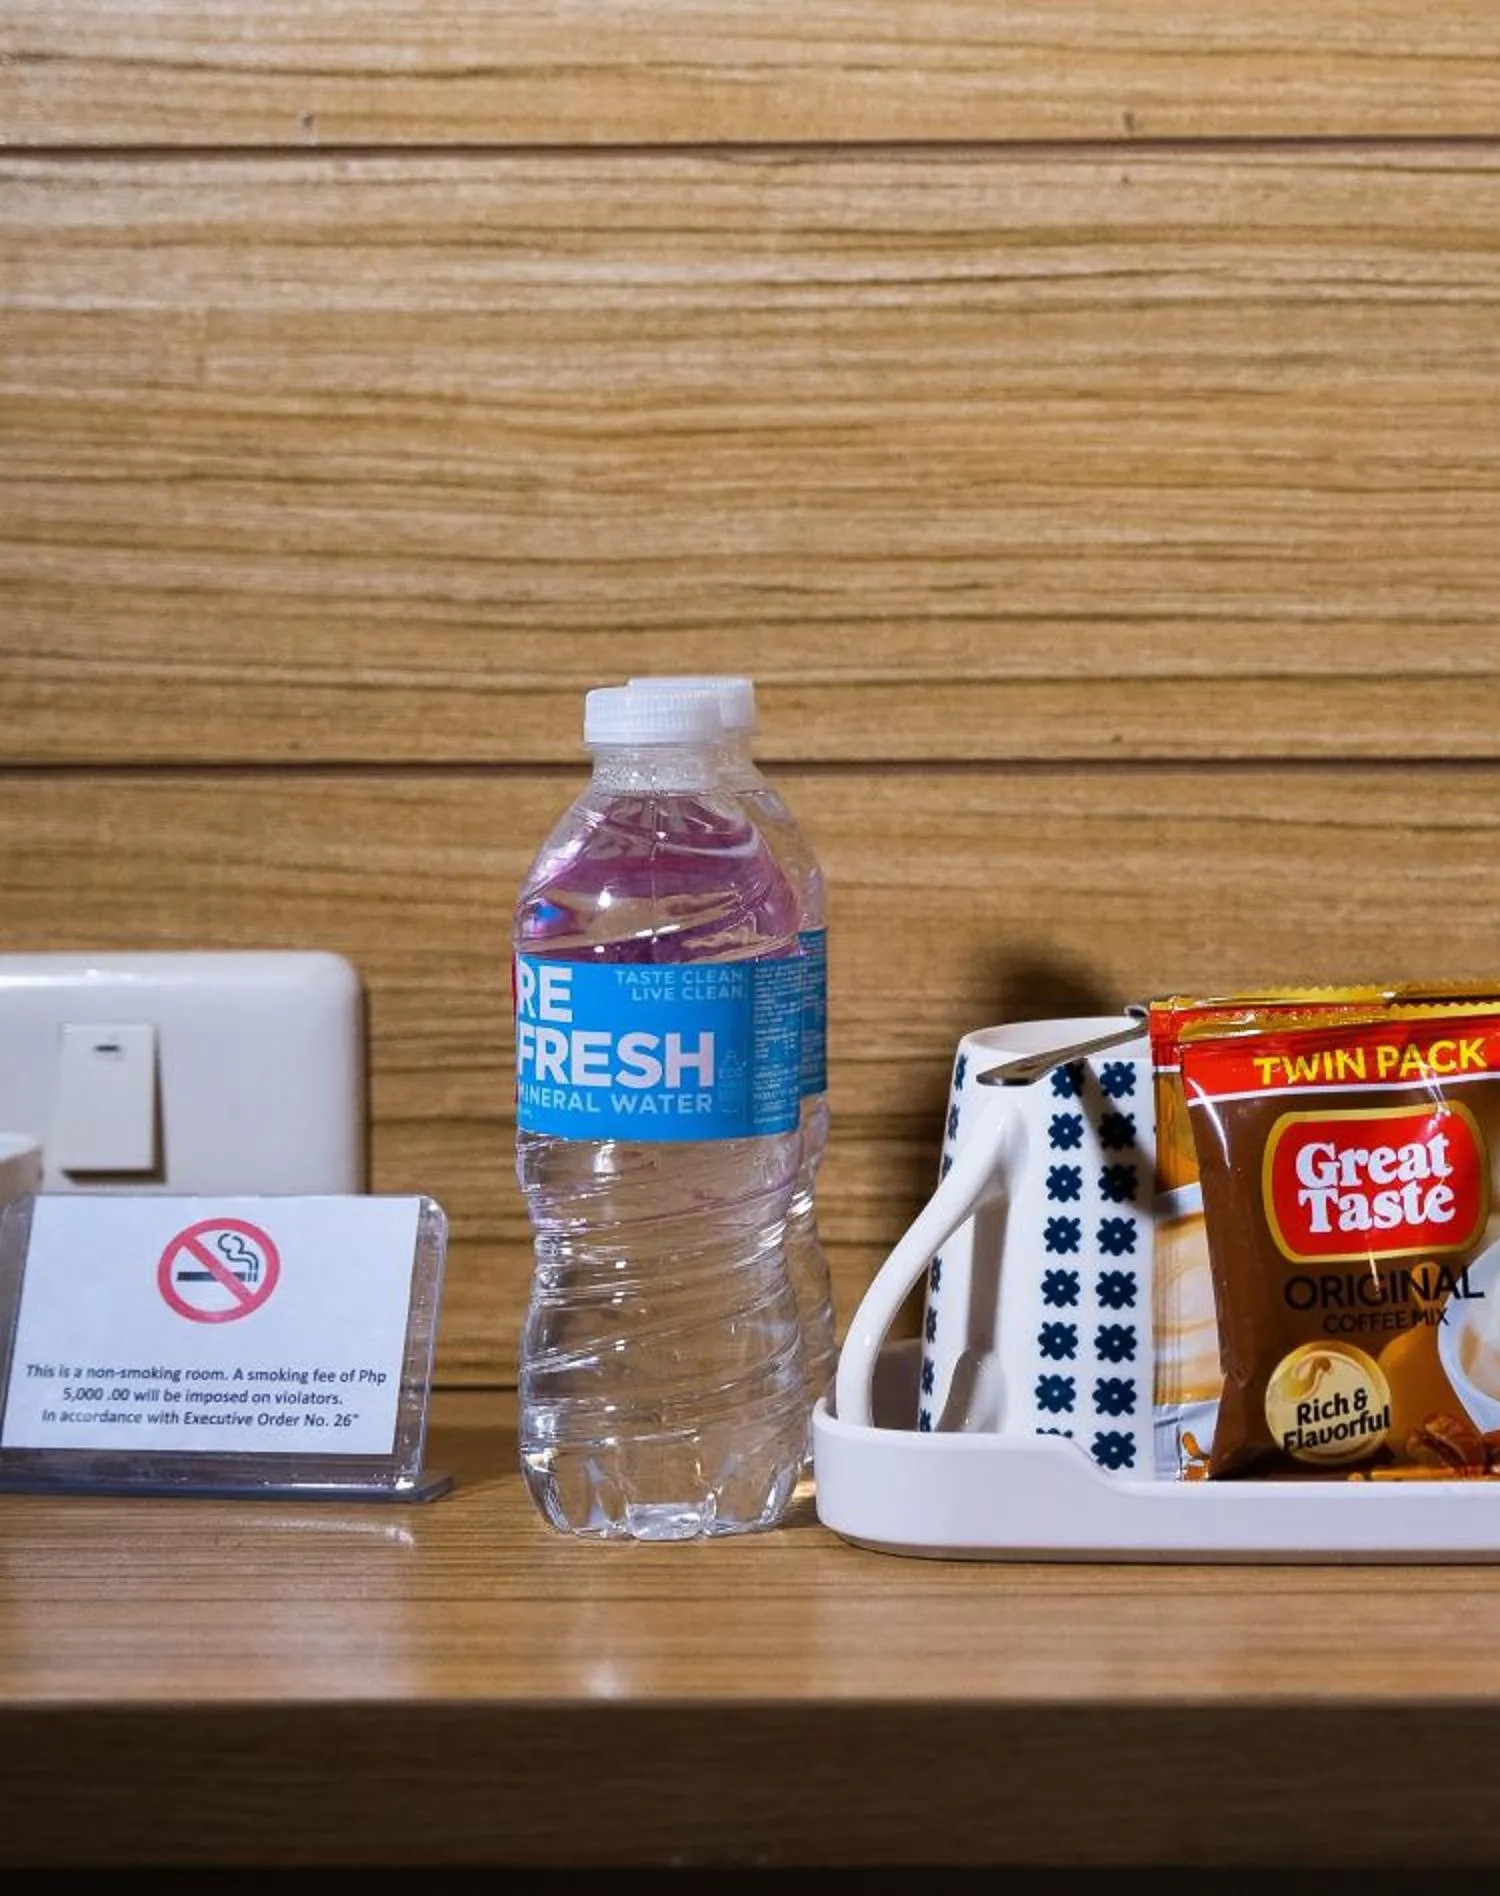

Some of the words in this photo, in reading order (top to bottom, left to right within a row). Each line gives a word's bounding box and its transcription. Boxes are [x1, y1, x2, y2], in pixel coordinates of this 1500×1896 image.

[616, 970, 675, 985] TASTE
[632, 986, 675, 1001] LIVE
[518, 1021, 715, 1089] FRESH
[1254, 1046, 1367, 1085] TWIN
[1377, 1038, 1487, 1079] PACK
[611, 1093, 712, 1115] WATER
[1296, 1132, 1453, 1190] Great
[1298, 1183, 1457, 1234] Taste
[1284, 1266, 1485, 1311] ORIGINAL
[1323, 1311, 1408, 1335] COFFEE
[1410, 1307, 1449, 1327] MIX
[26, 1364, 54, 1378] This
[59, 1364, 71, 1379] is
[74, 1368, 82, 1379] a
[86, 1365, 181, 1383] non-smoking
[185, 1369, 228, 1381] room.
[232, 1368, 243, 1381] A
[247, 1368, 309, 1384] smoking
[313, 1368, 335, 1382] fee
[339, 1369, 356, 1383] of
[358, 1369, 387, 1386] Php
[63, 1388, 103, 1402] 5,000
[134, 1388, 161, 1402] will
[163, 1390, 181, 1403] be
[185, 1390, 248, 1406] imposed
[252, 1393, 271, 1404] on
[275, 1392, 343, 1405] violators.
[1297, 1394, 1349, 1426] Rich
[1354, 1387, 1368, 1411] &
[42, 1409, 56, 1422] In
[59, 1410, 142, 1424] accordance
[147, 1411, 178, 1424] with
[184, 1412, 252, 1426] Executive
[257, 1413, 300, 1427] Order
[303, 1414, 329, 1427] No.
[1283, 1407, 1391, 1452] Flavorful
